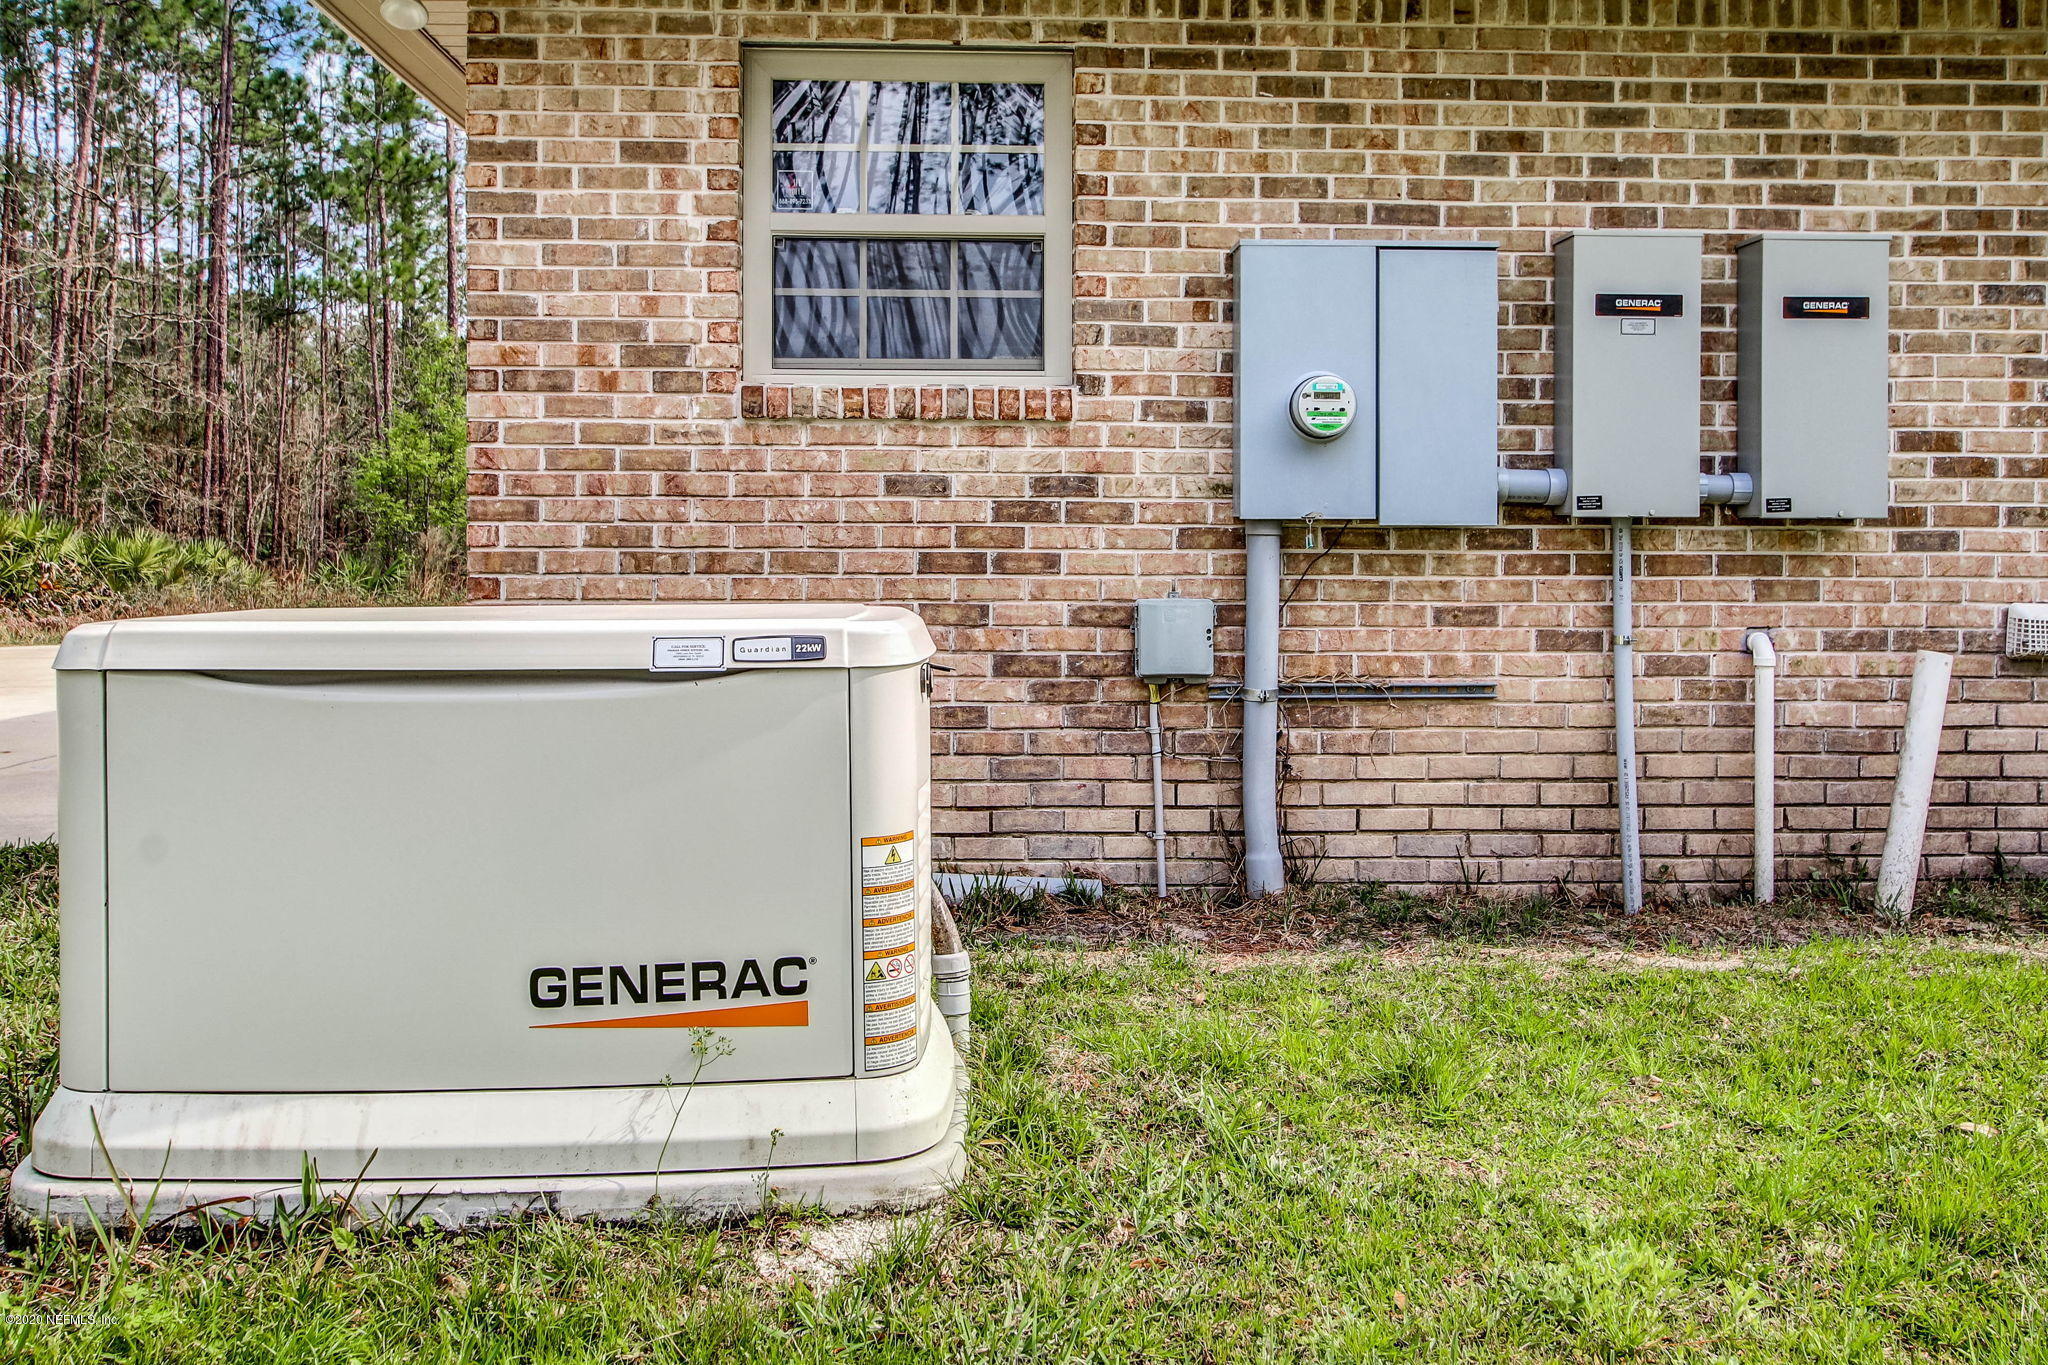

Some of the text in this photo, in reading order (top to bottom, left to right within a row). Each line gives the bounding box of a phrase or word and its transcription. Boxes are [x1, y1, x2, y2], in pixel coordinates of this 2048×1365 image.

[1615, 299, 1661, 307] GENERAC
[1803, 301, 1849, 309] GENERAC
[739, 646, 787, 654] Guardian
[795, 643, 822, 653] 22kW
[883, 834, 907, 843] WARNING
[885, 947, 909, 956] WARNING
[529, 956, 808, 1009] GENERAC
